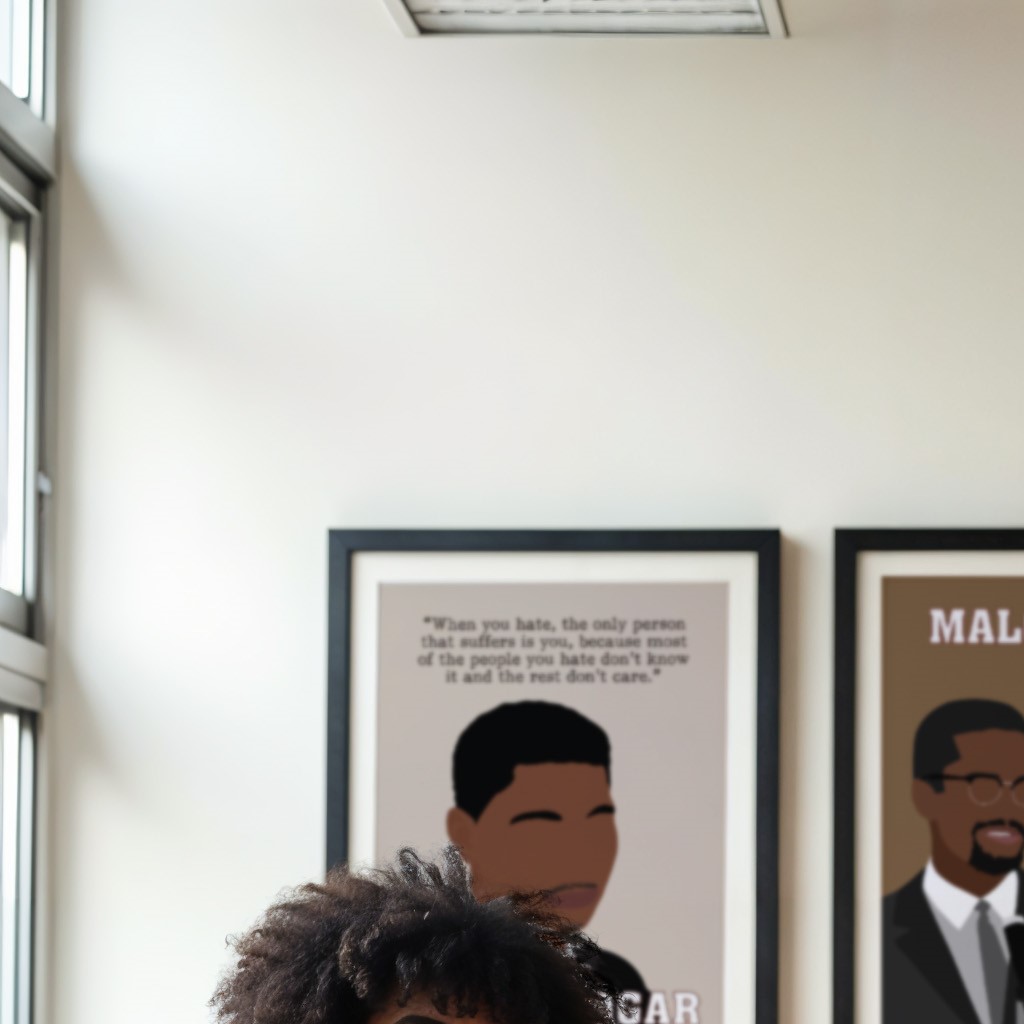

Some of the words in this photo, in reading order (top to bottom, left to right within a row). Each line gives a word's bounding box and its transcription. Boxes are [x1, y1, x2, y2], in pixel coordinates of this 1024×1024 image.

[423, 616, 476, 631] "When
[482, 620, 510, 635] you
[516, 616, 556, 632] hate,
[561, 616, 588, 631] the
[593, 616, 627, 635] only
[632, 619, 686, 635] person
[421, 635, 454, 649] that
[460, 635, 515, 649] suffers
[521, 635, 534, 649] is
[540, 637, 574, 652] you,
[579, 634, 641, 649] because
[647, 635, 687, 649] most
[417, 652, 434, 666] of
[439, 652, 464, 666] the
[470, 653, 521, 669] people
[527, 655, 553, 669] you
[560, 652, 595, 666] hate
[600, 652, 641, 666] don't
[647, 652, 689, 666] know
[445, 669, 457, 684] it
[463, 669, 492, 684] and
[498, 669, 524, 684] the
[530, 669, 560, 684] rest
[566, 669, 607, 684] don't
[612, 668, 661, 684] care."
